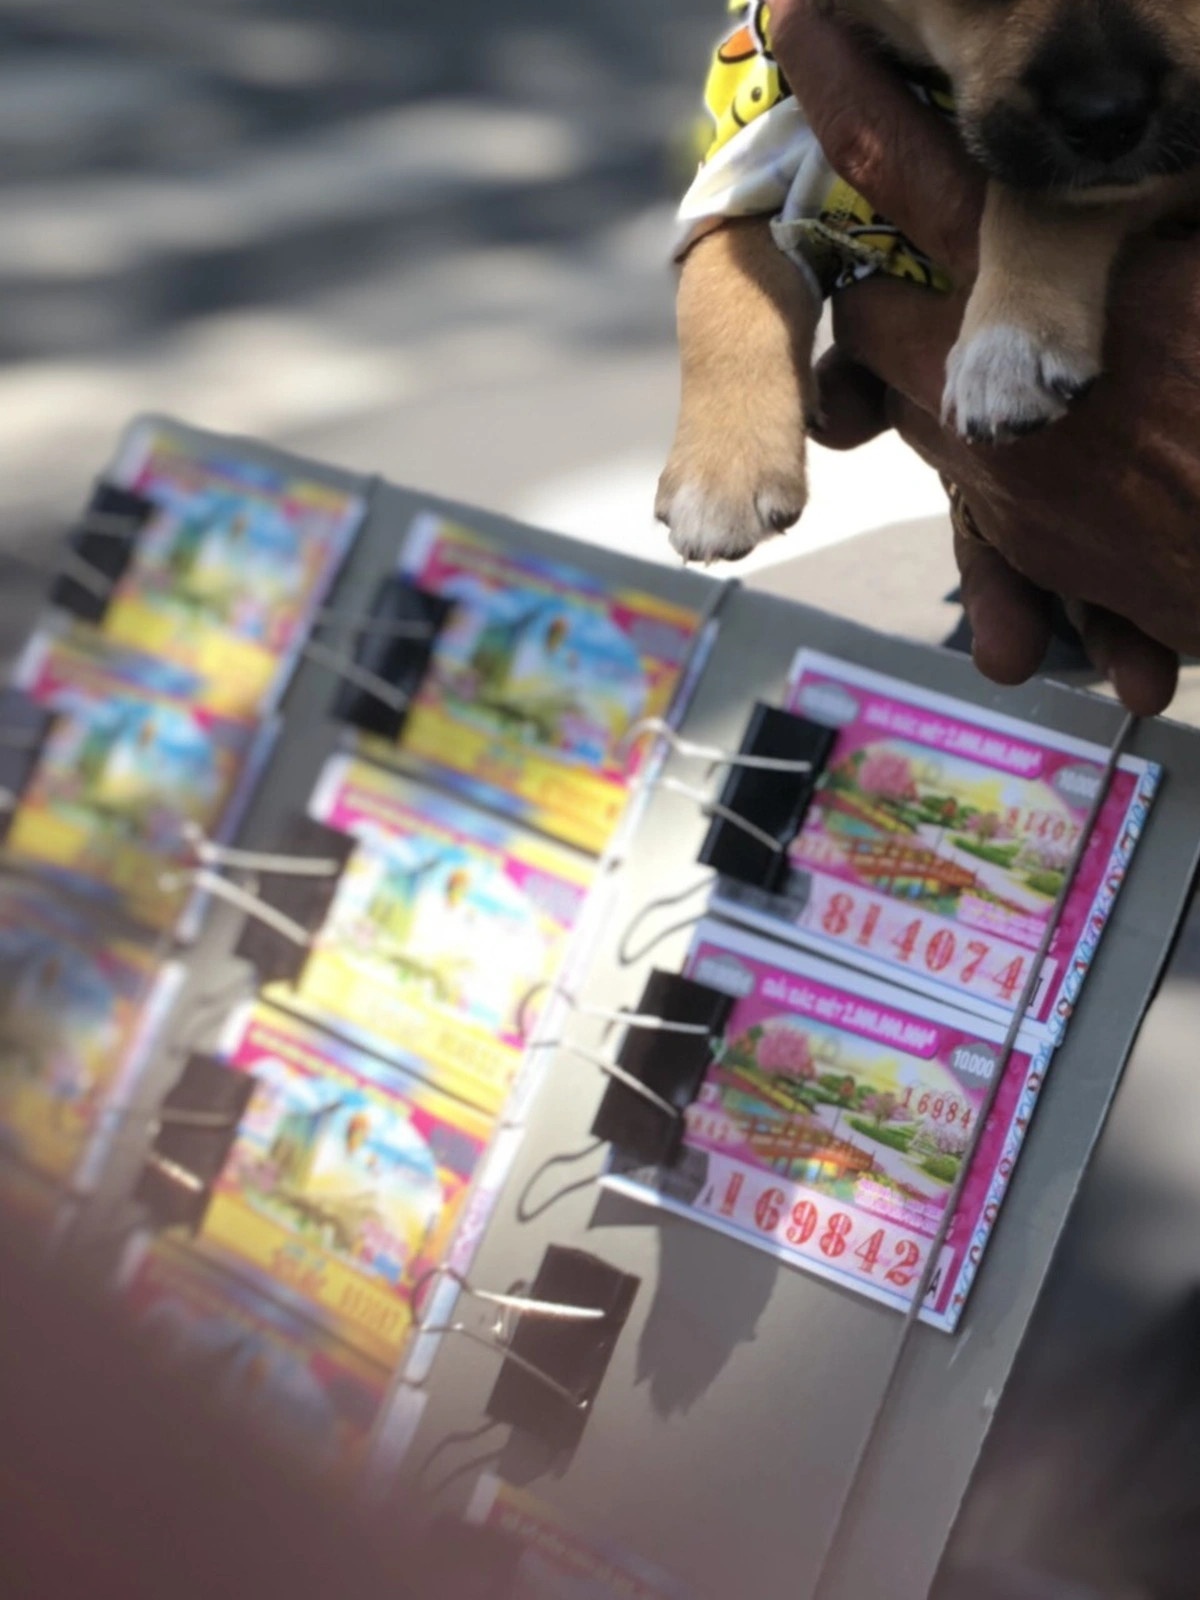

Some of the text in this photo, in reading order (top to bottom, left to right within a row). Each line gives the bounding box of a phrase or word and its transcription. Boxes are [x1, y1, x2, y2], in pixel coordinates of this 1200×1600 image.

[821, 891, 1025, 1001] 814074
[901, 1086, 973, 1130] 16984
[719, 1171, 921, 1287] 169842
